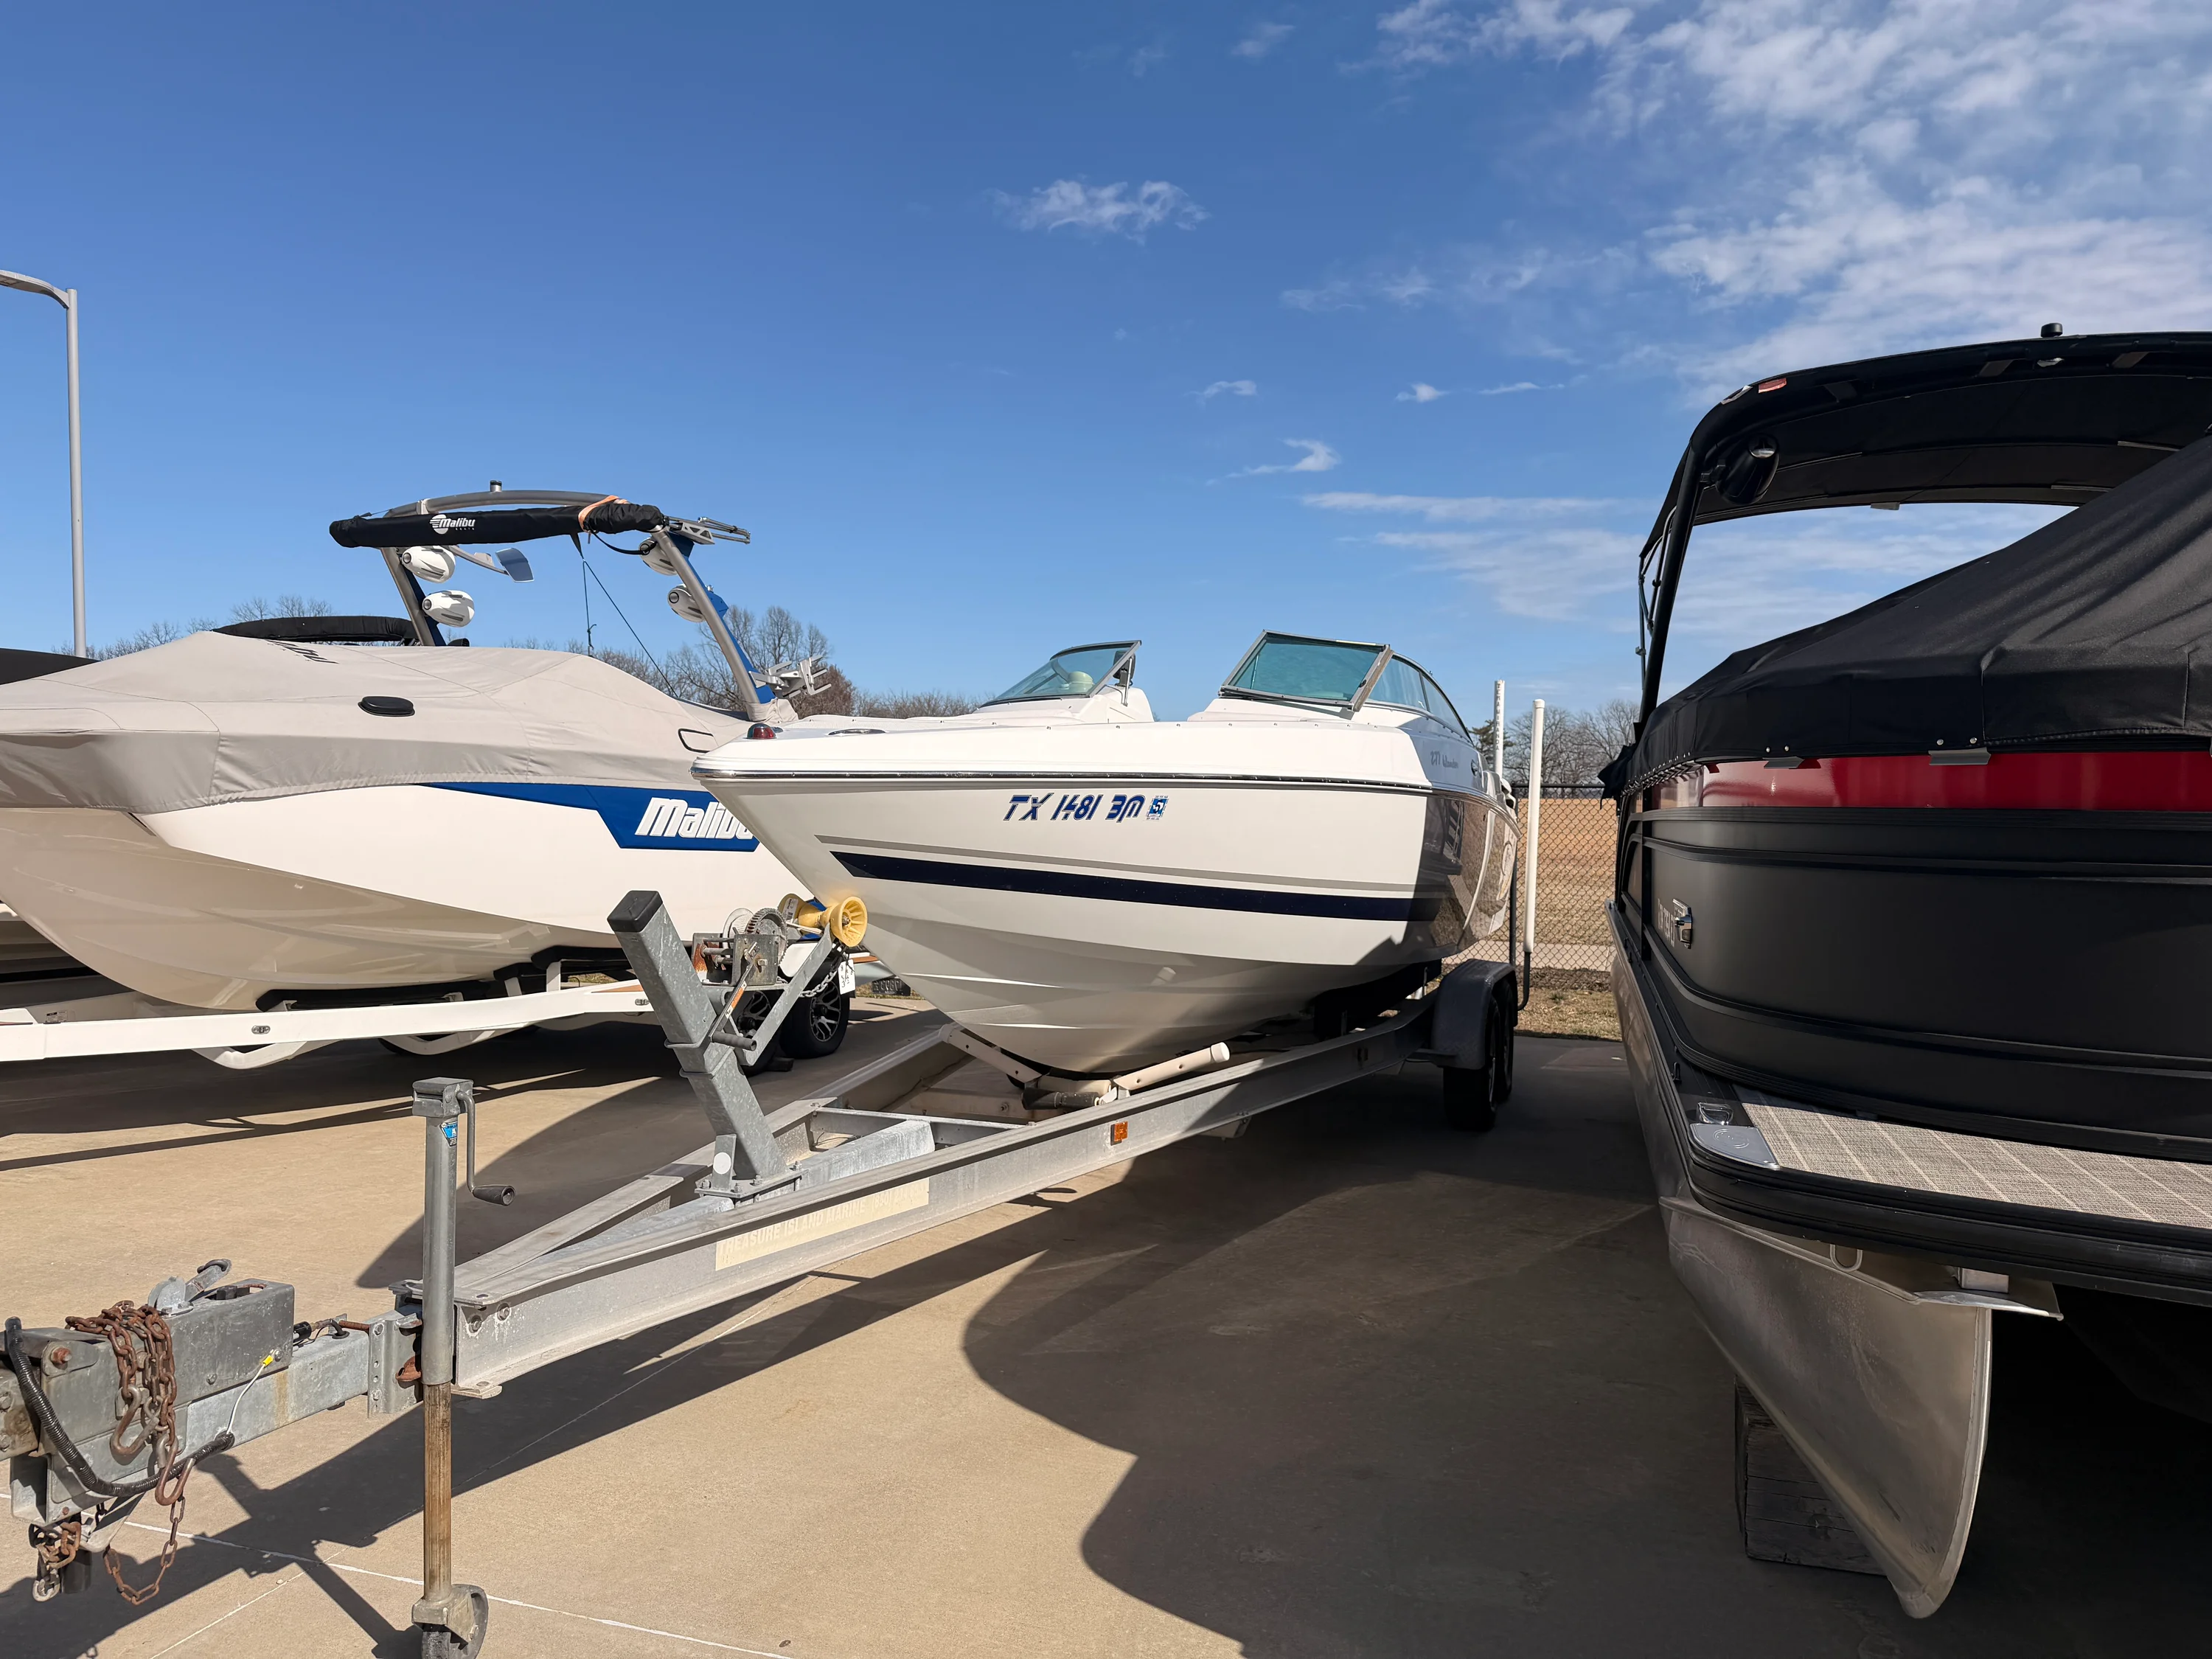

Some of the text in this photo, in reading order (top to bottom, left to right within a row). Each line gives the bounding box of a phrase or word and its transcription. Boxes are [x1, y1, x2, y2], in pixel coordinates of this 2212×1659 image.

[439, 518, 476, 528] Malibu
[1004, 793, 1054, 821] TX
[717, 1224, 781, 1256] TREASURE
[784, 1211, 823, 1237] ISLAND
[826, 1199, 866, 1224] MARINE
